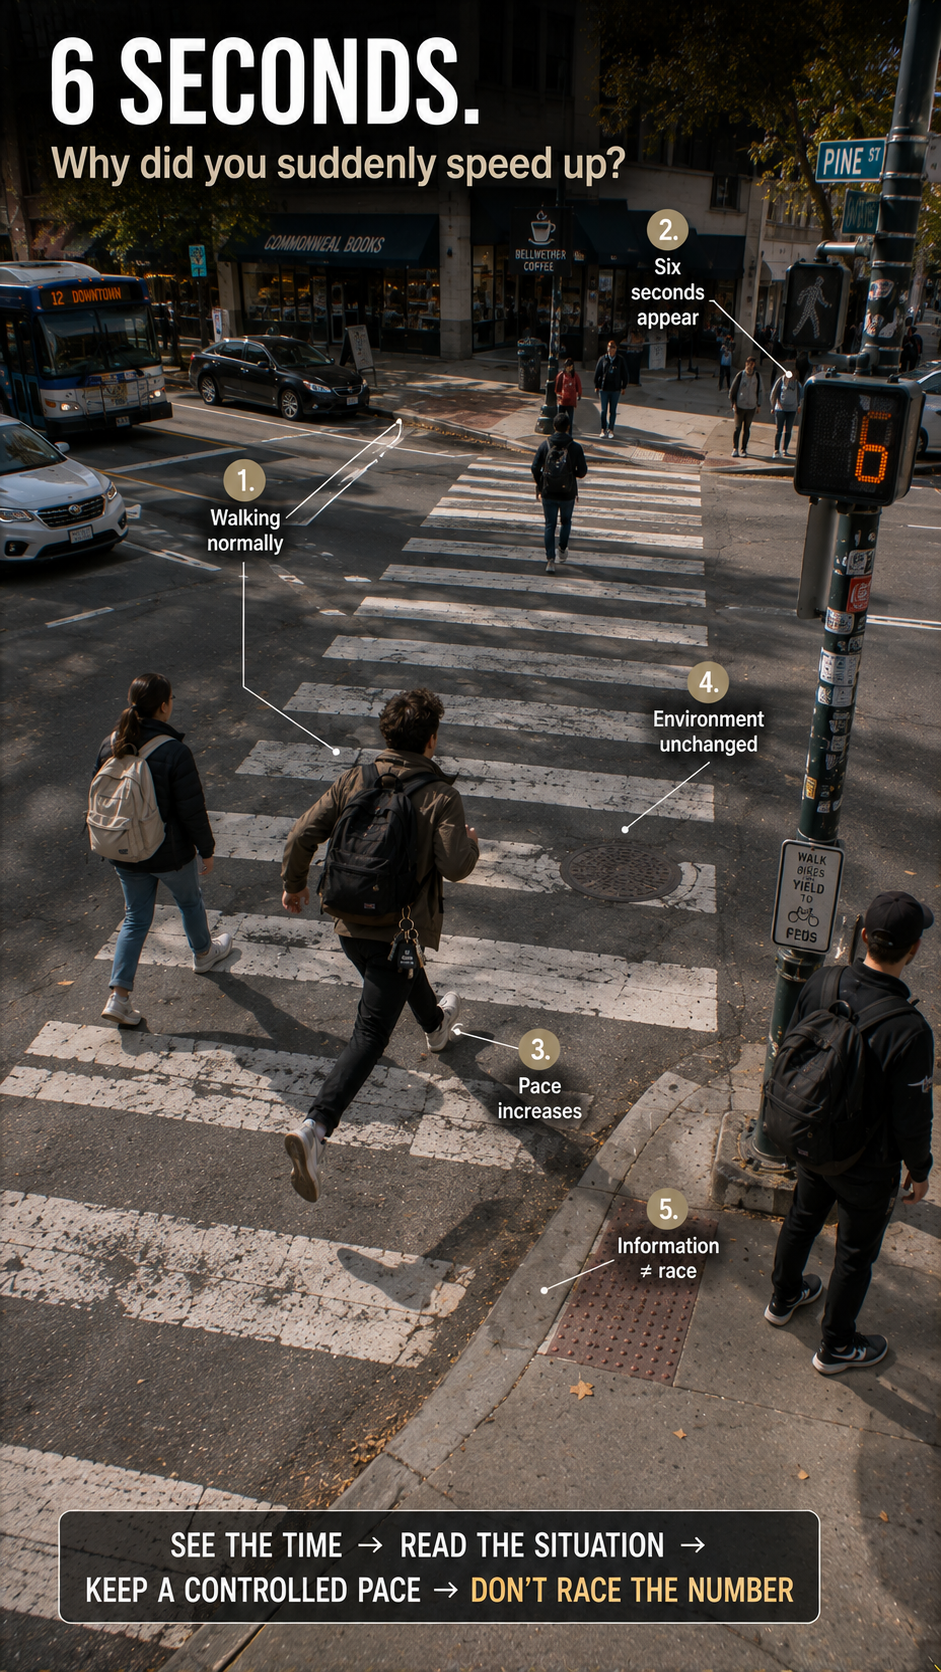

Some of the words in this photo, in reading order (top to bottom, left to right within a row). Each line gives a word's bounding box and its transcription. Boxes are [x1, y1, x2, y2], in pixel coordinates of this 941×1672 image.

[823, 147, 864, 175] PINE
[868, 147, 882, 163] ST
[264, 234, 342, 253] COMMONWEAL
[343, 235, 386, 254] BOOKS
[515, 248, 567, 260] BELLWETHER
[523, 260, 555, 272] COFFEE
[51, 290, 65, 306] 12
[71, 286, 122, 304] DOWNTOWN
[854, 411, 892, 484] 6
[798, 852, 827, 866] WALK
[793, 879, 825, 894] YIELD
